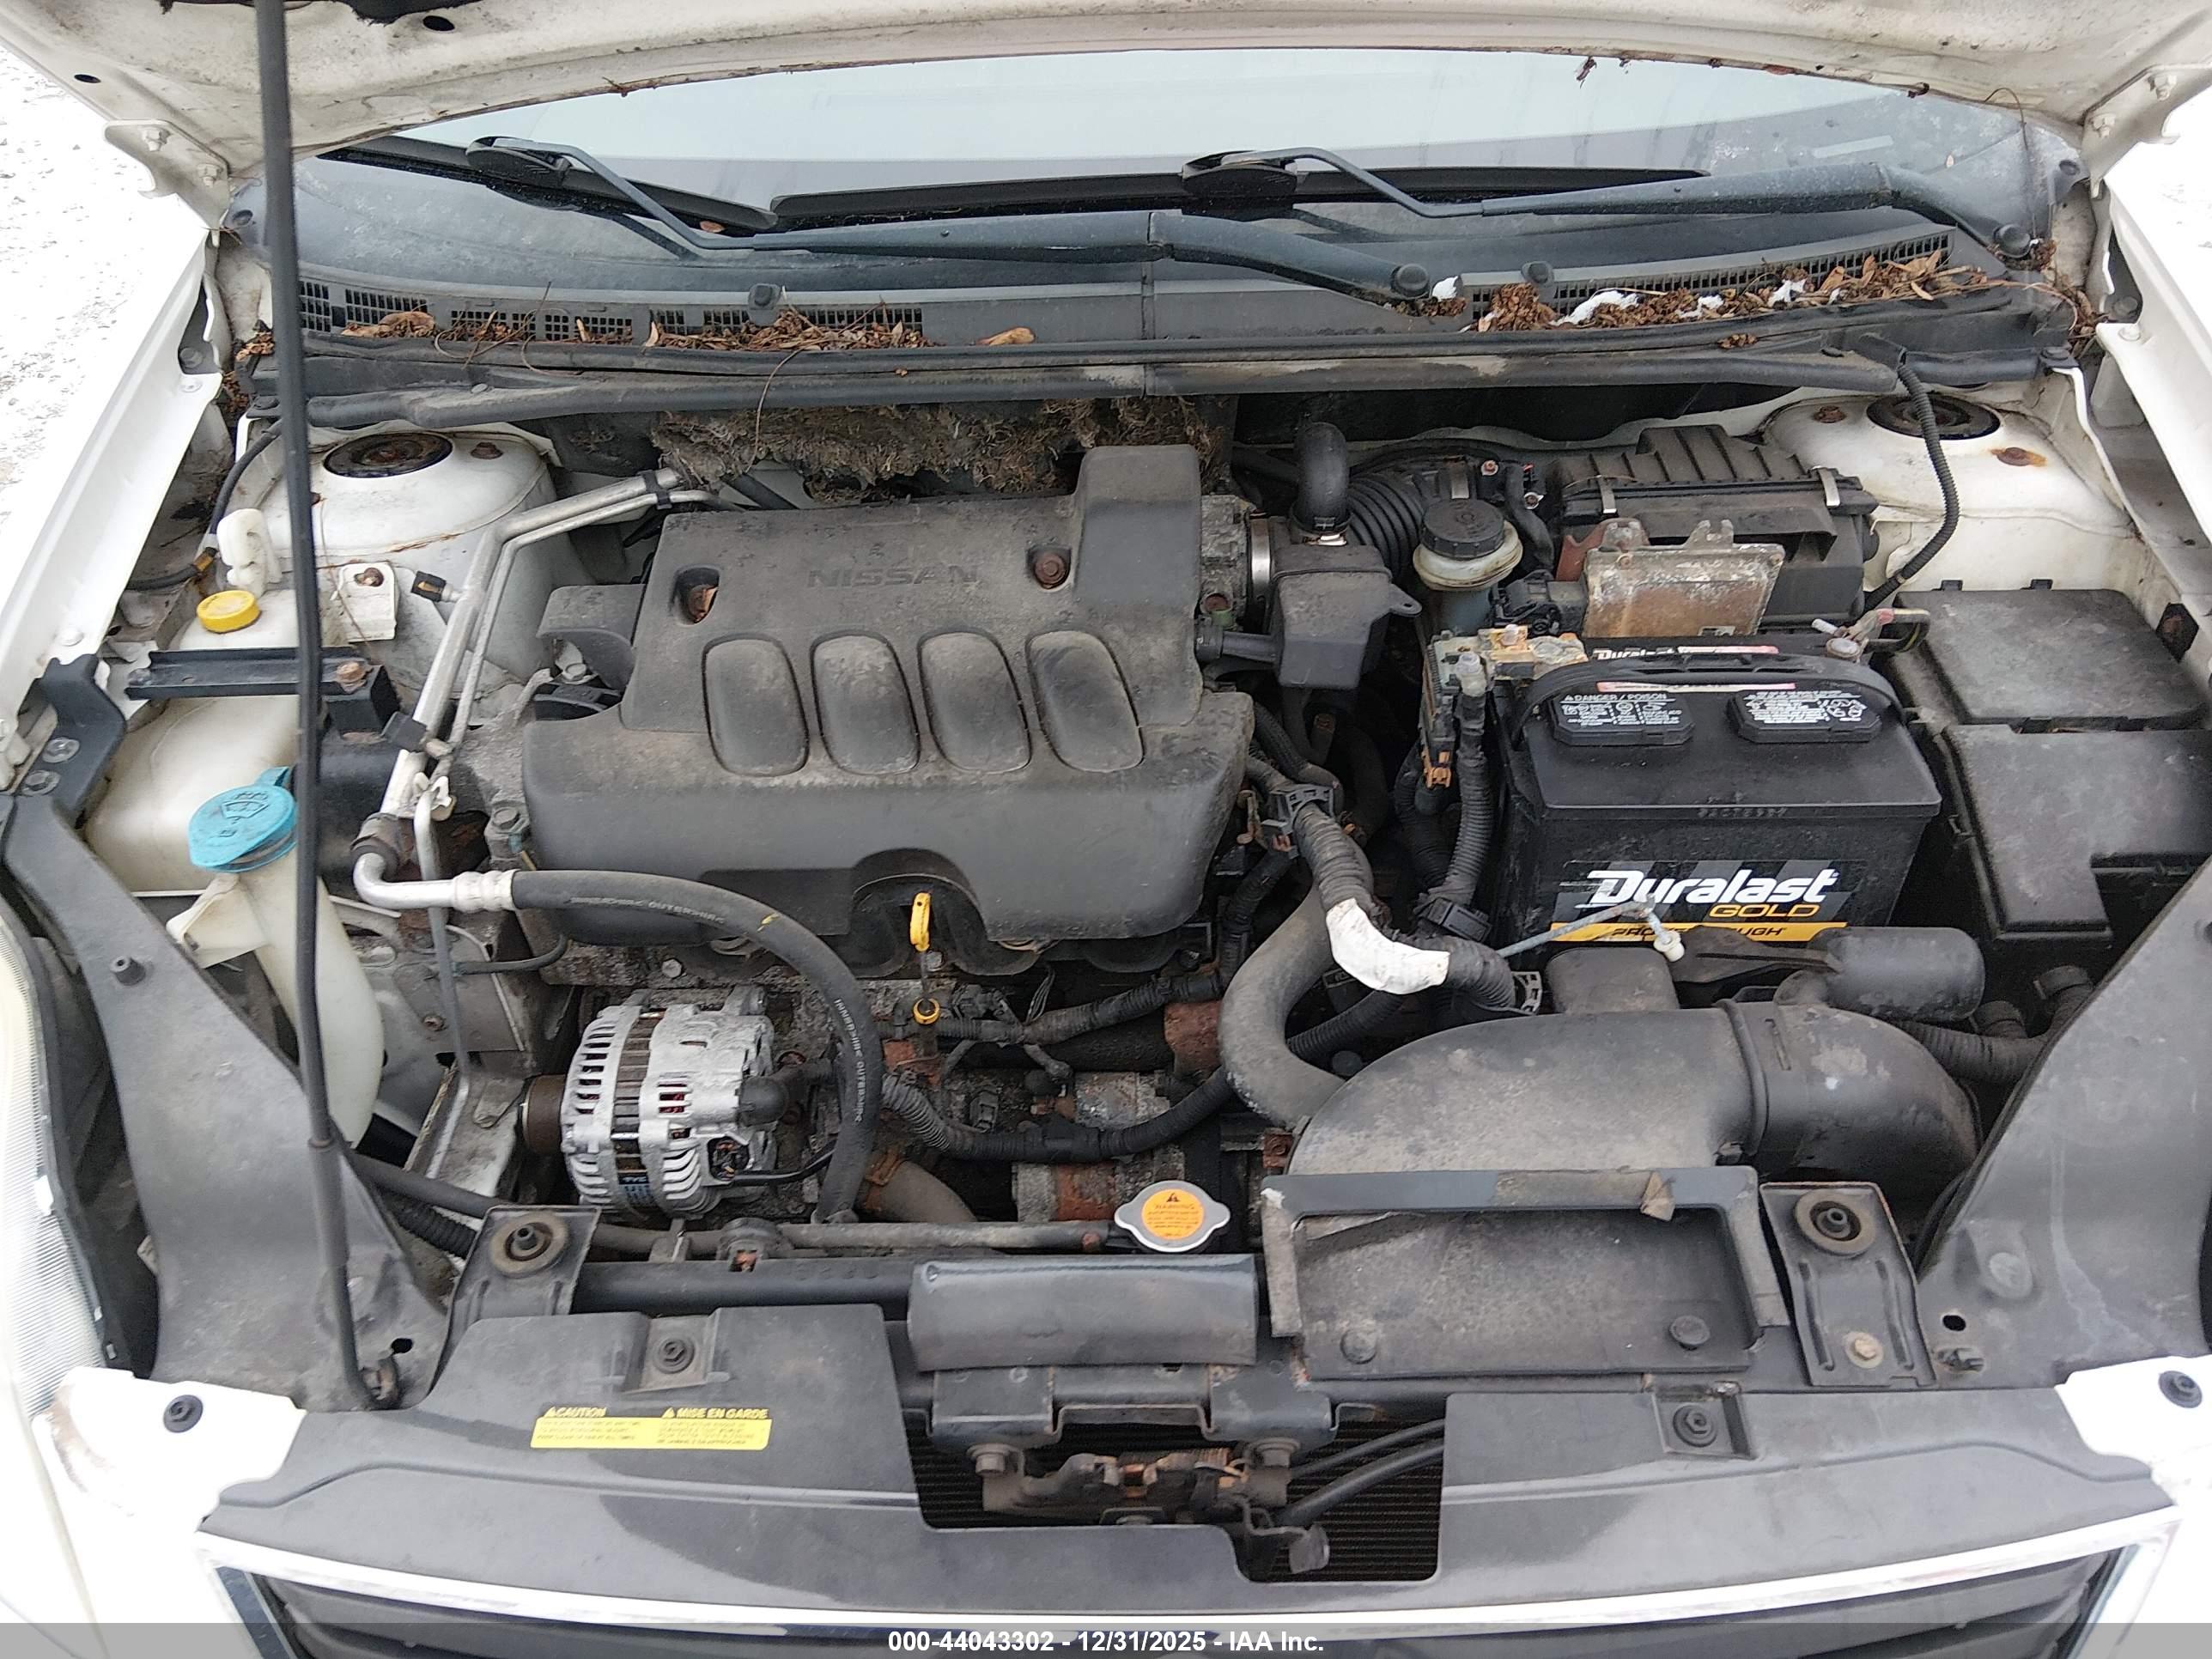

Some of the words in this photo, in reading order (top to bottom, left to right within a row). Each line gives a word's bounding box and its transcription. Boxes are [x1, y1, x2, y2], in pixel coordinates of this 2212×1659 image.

[807, 564, 977, 587] NISSAN
[1586, 869, 1838, 907] Duralast
[1709, 904, 1820, 918] GOLD
[556, 1407, 608, 1419] CAUTION
[676, 1407, 708, 1419] MISE
[707, 1407, 726, 1419] EN
[726, 1408, 769, 1419] GARDE
